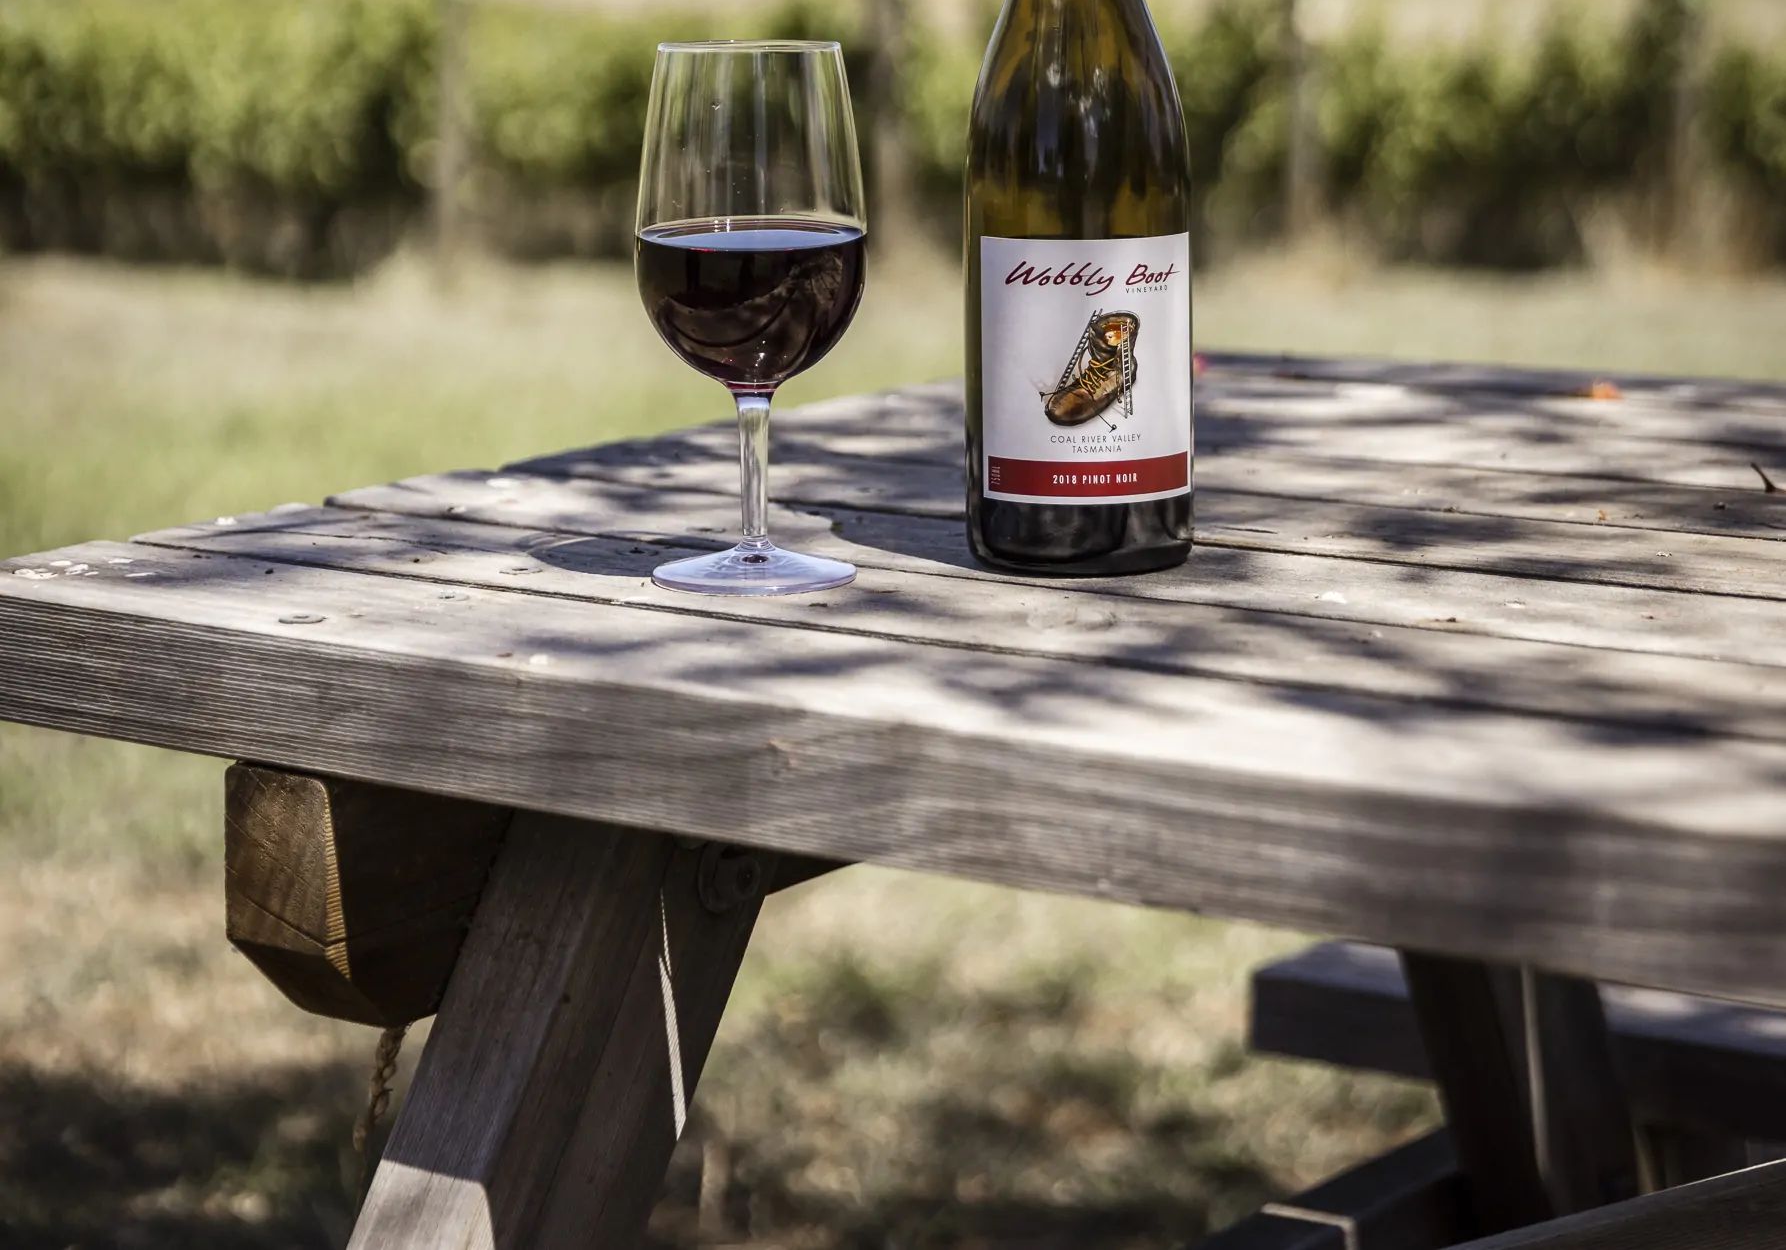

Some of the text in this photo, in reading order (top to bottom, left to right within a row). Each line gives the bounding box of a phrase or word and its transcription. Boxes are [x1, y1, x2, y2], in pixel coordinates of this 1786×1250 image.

[1005, 260, 1180, 297] Wobbly Boot
[1125, 284, 1168, 294] VINEYARD
[1050, 433, 1141, 444] COAL RIVER VALLEY
[1072, 445, 1122, 454] TASMANIA
[1052, 472, 1138, 485] 2018 PINOT NOIR
